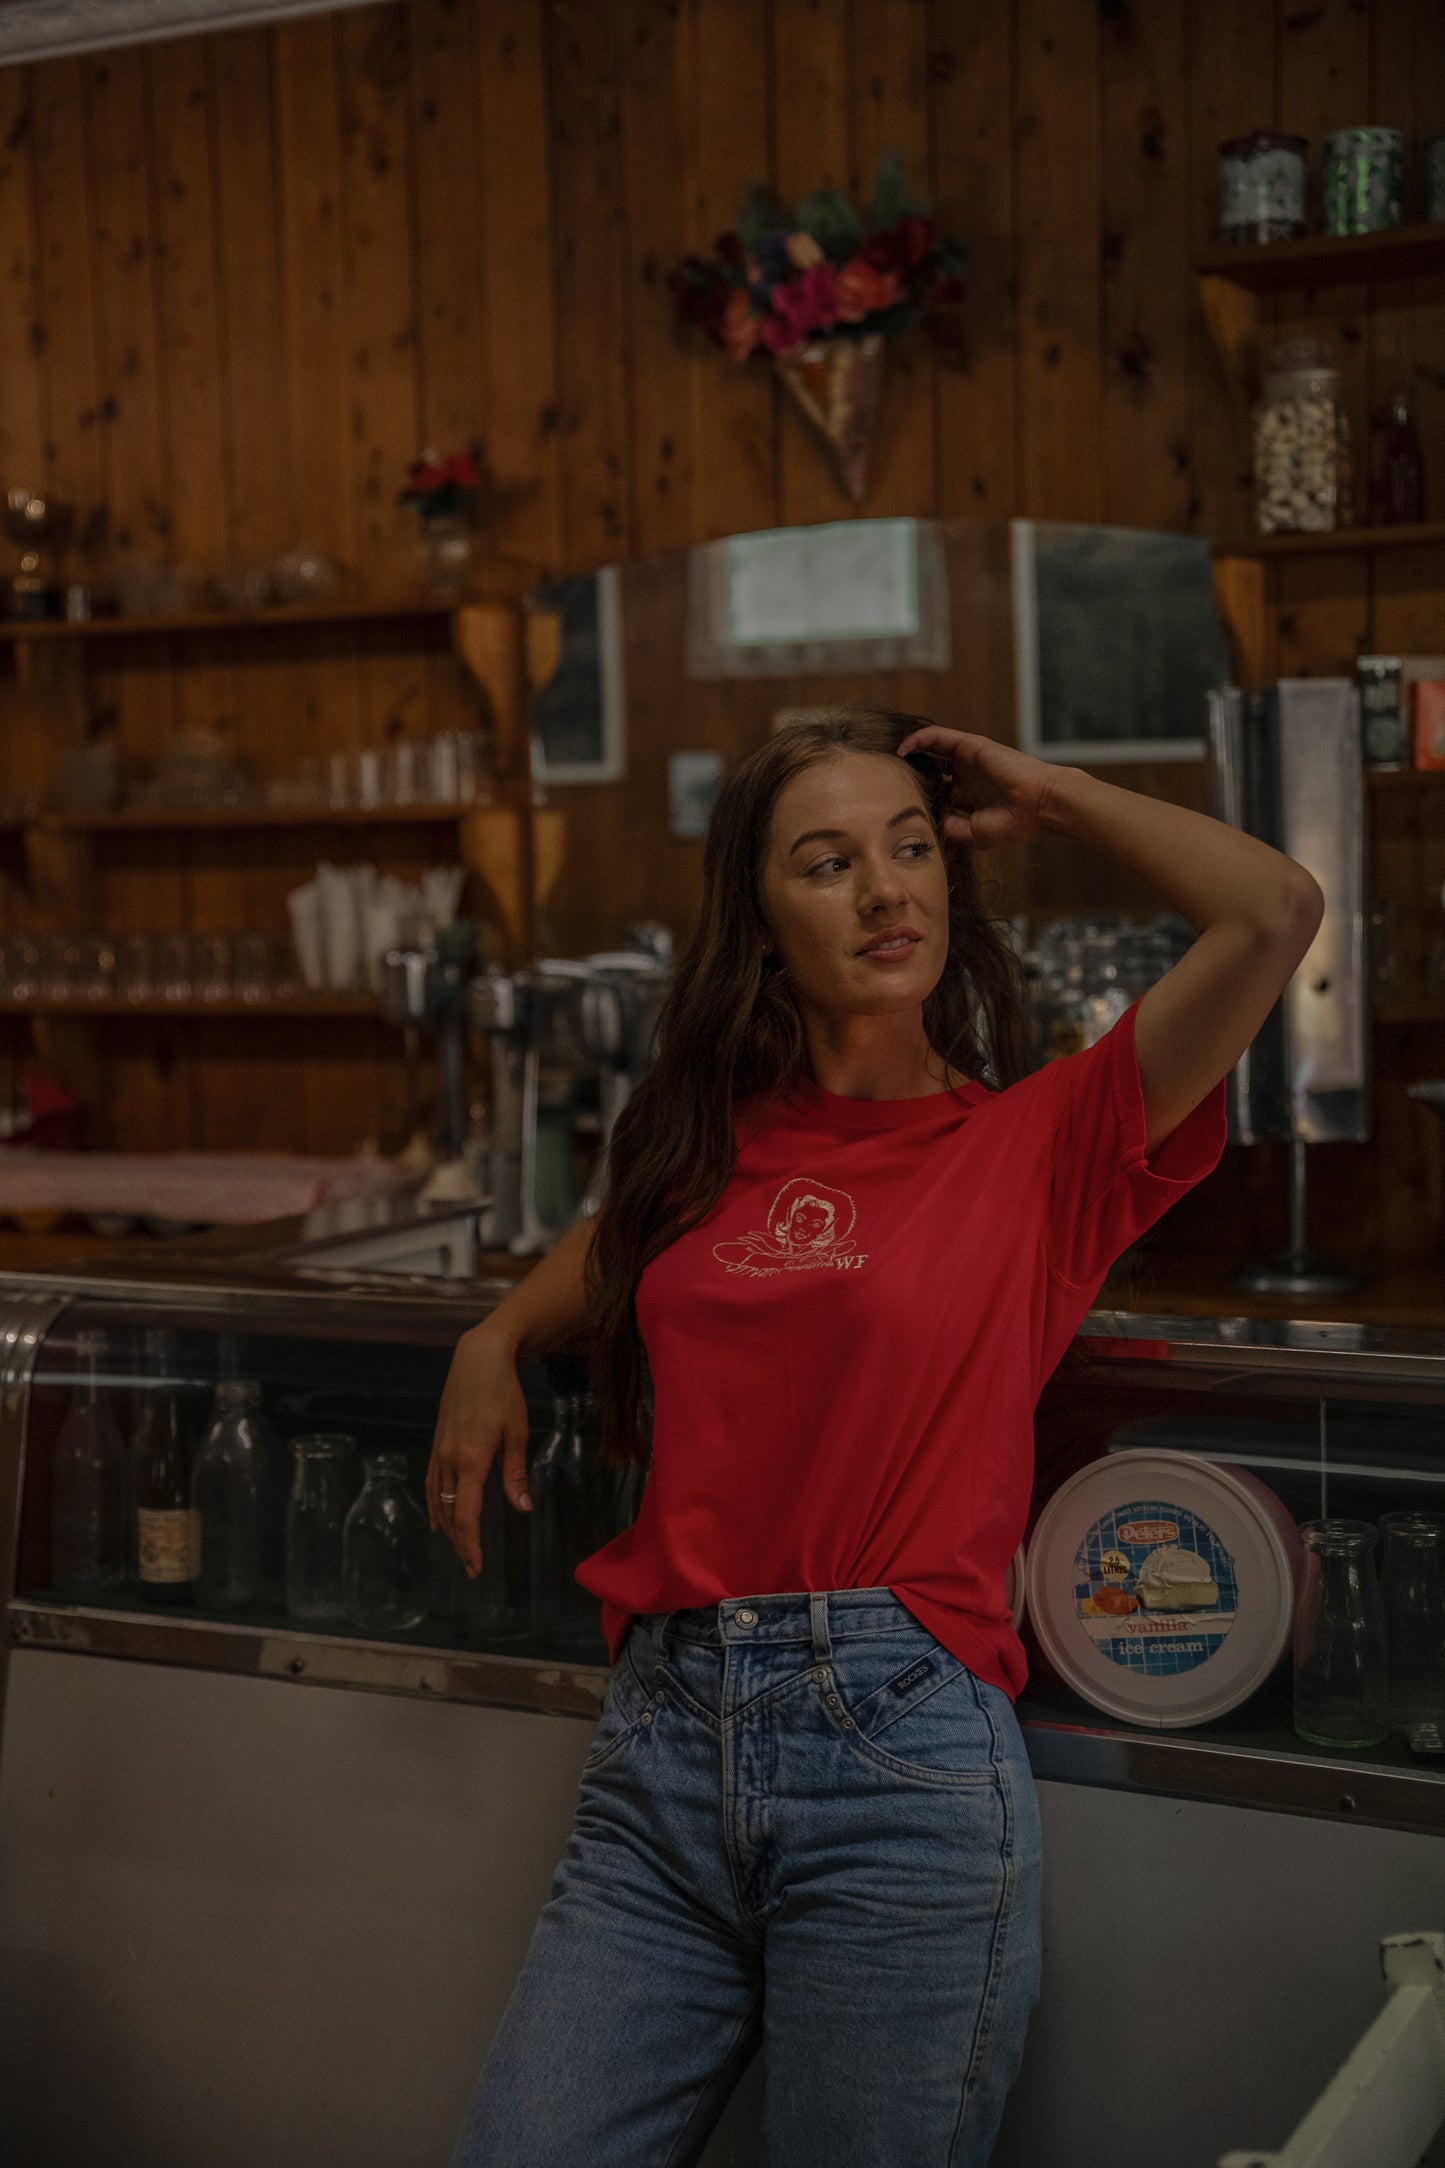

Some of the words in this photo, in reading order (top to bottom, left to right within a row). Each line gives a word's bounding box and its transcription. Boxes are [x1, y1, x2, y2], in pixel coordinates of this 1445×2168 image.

[834, 1254, 869, 1270] WF
[1121, 1523, 1177, 1541] Peters
[1108, 1556, 1120, 1565] 2.5
[1127, 1618, 1187, 1634] vanilla
[1119, 1641, 1143, 1655] ice
[1149, 1641, 1204, 1654] cream
[897, 1664, 929, 1690] ROCKIES
